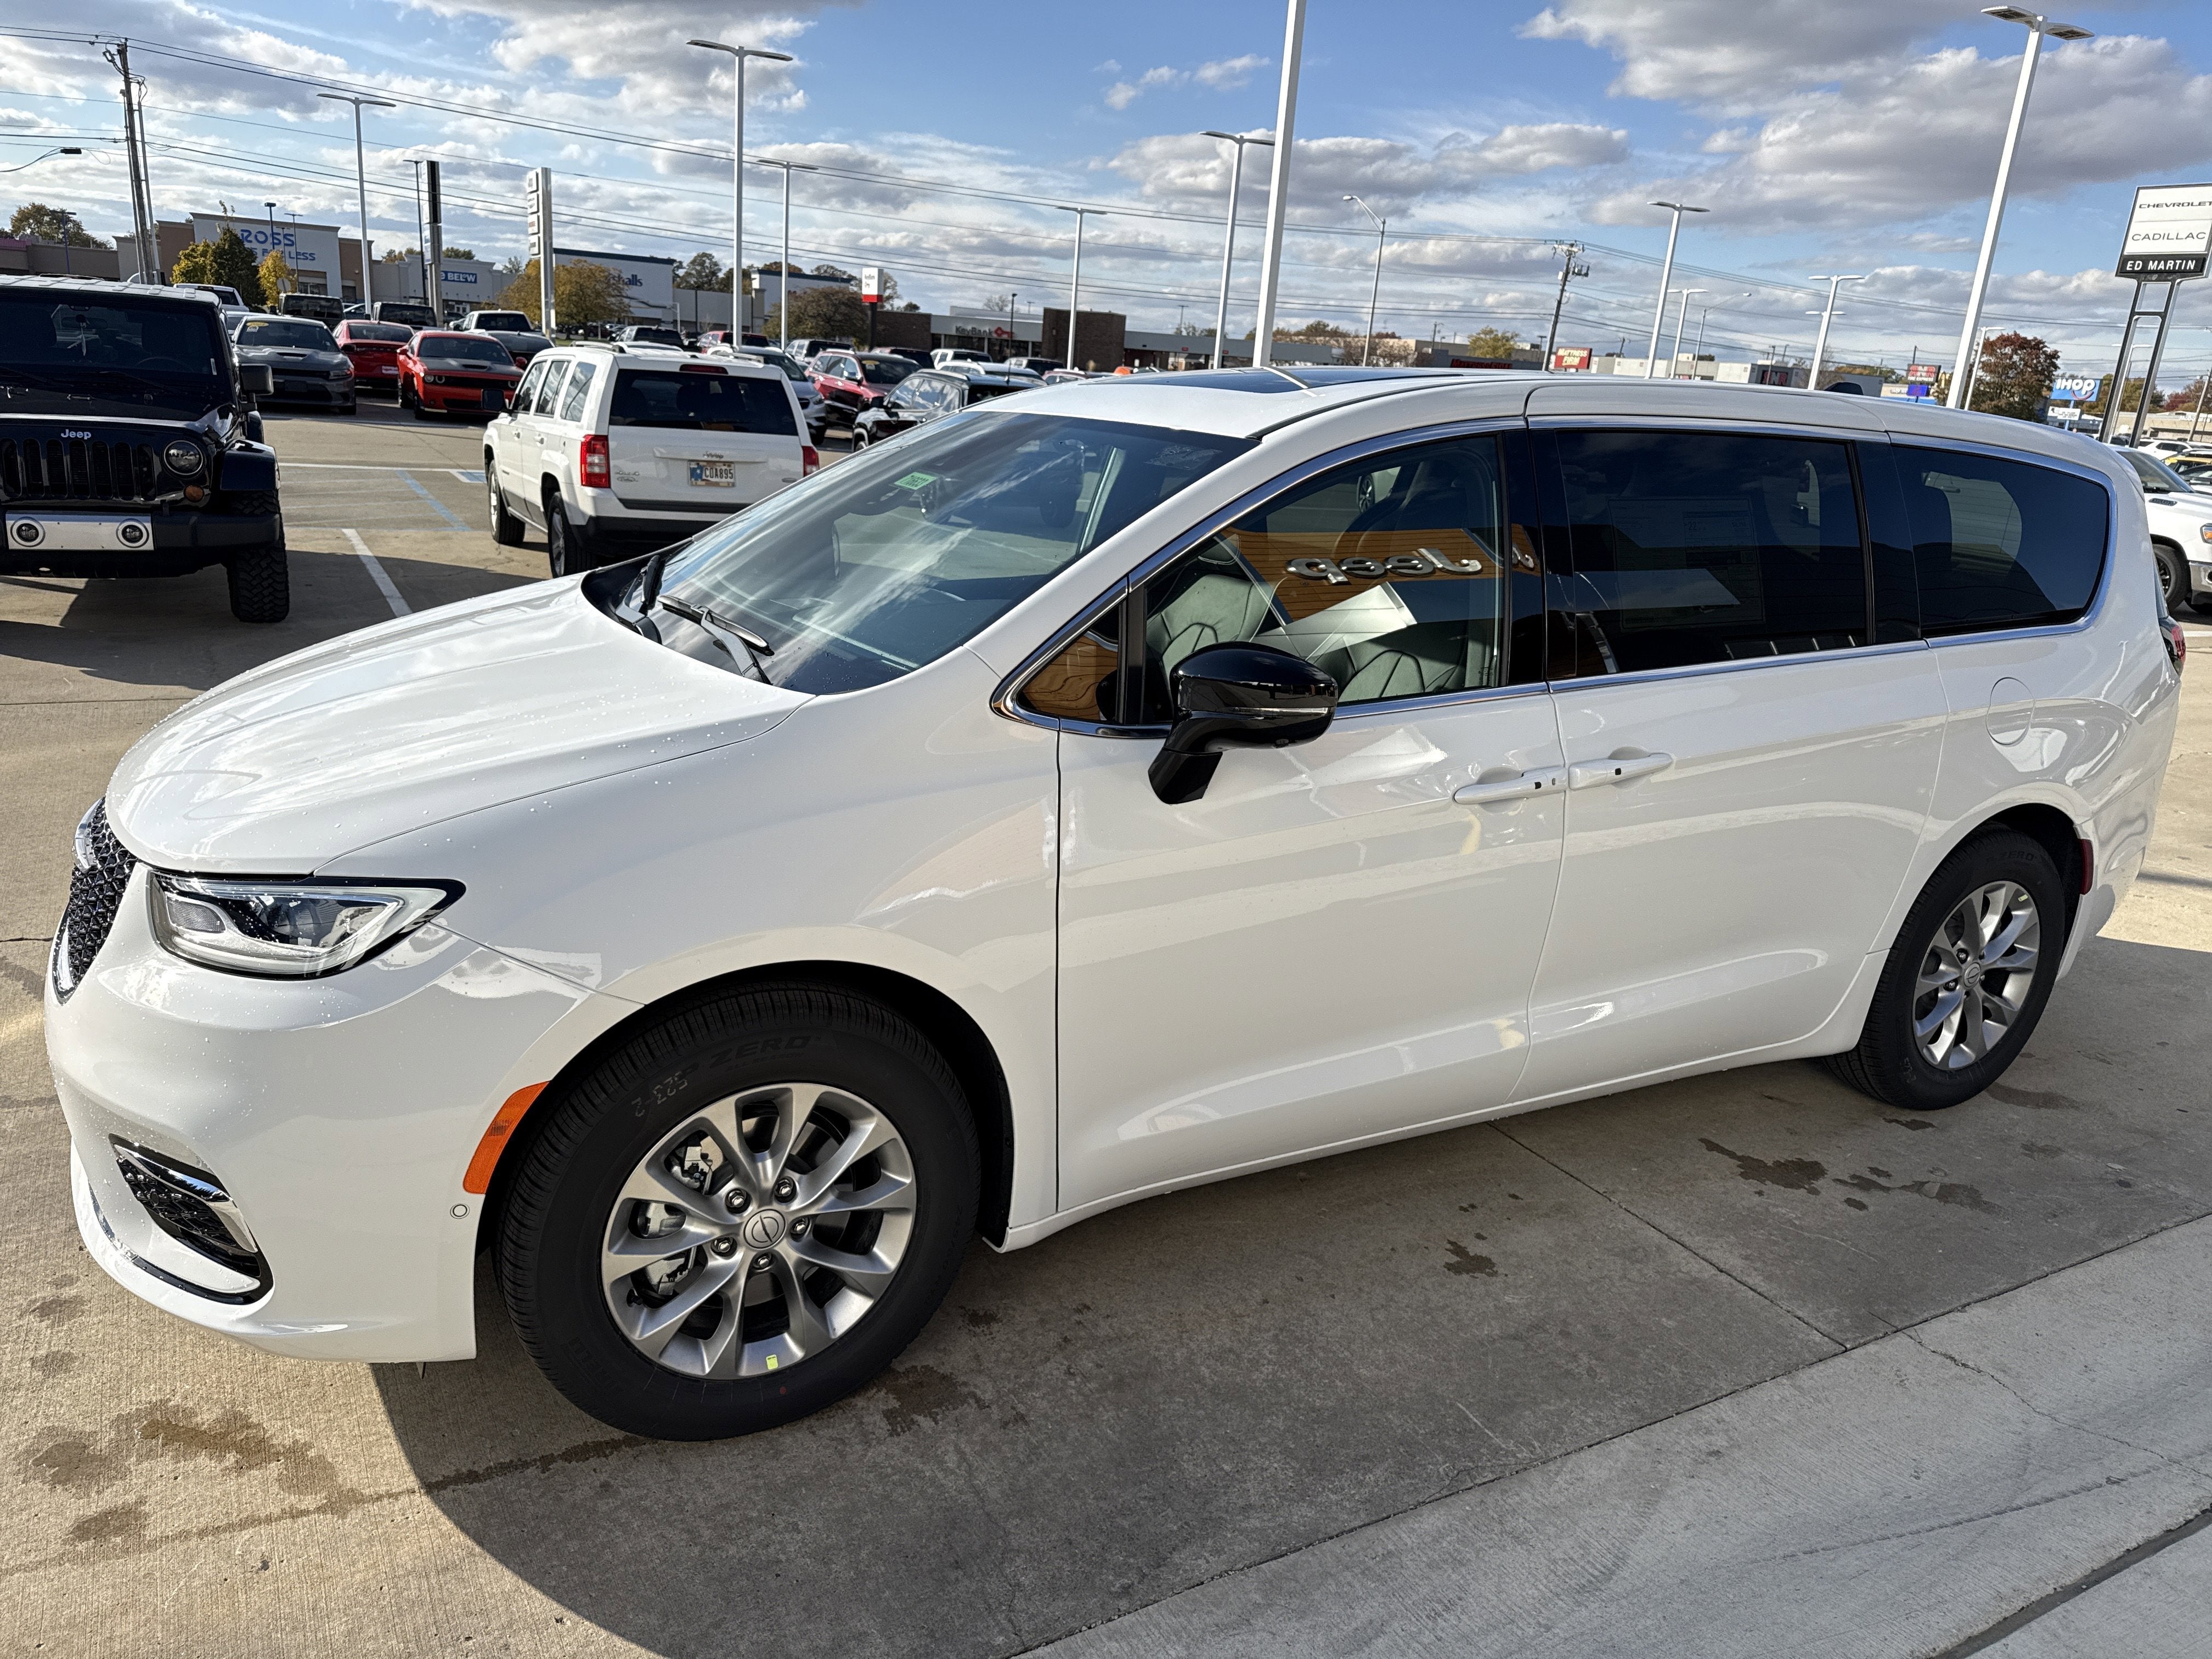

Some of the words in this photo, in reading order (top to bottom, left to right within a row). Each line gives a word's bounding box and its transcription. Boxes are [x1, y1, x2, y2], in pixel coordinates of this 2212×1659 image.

[240, 229, 295, 247] ROSS
[2131, 232, 2207, 241] CADILLAC
[289, 251, 316, 261] LESS
[2126, 260, 2142, 270] ED
[2148, 259, 2196, 270] MARTIN
[956, 326, 993, 336] KeyBank
[1558, 348, 1588, 358] MATTRESS
[1562, 356, 1581, 366] FIRM
[61, 428, 92, 440] Jeep
[709, 1035, 811, 1069] ZERO
